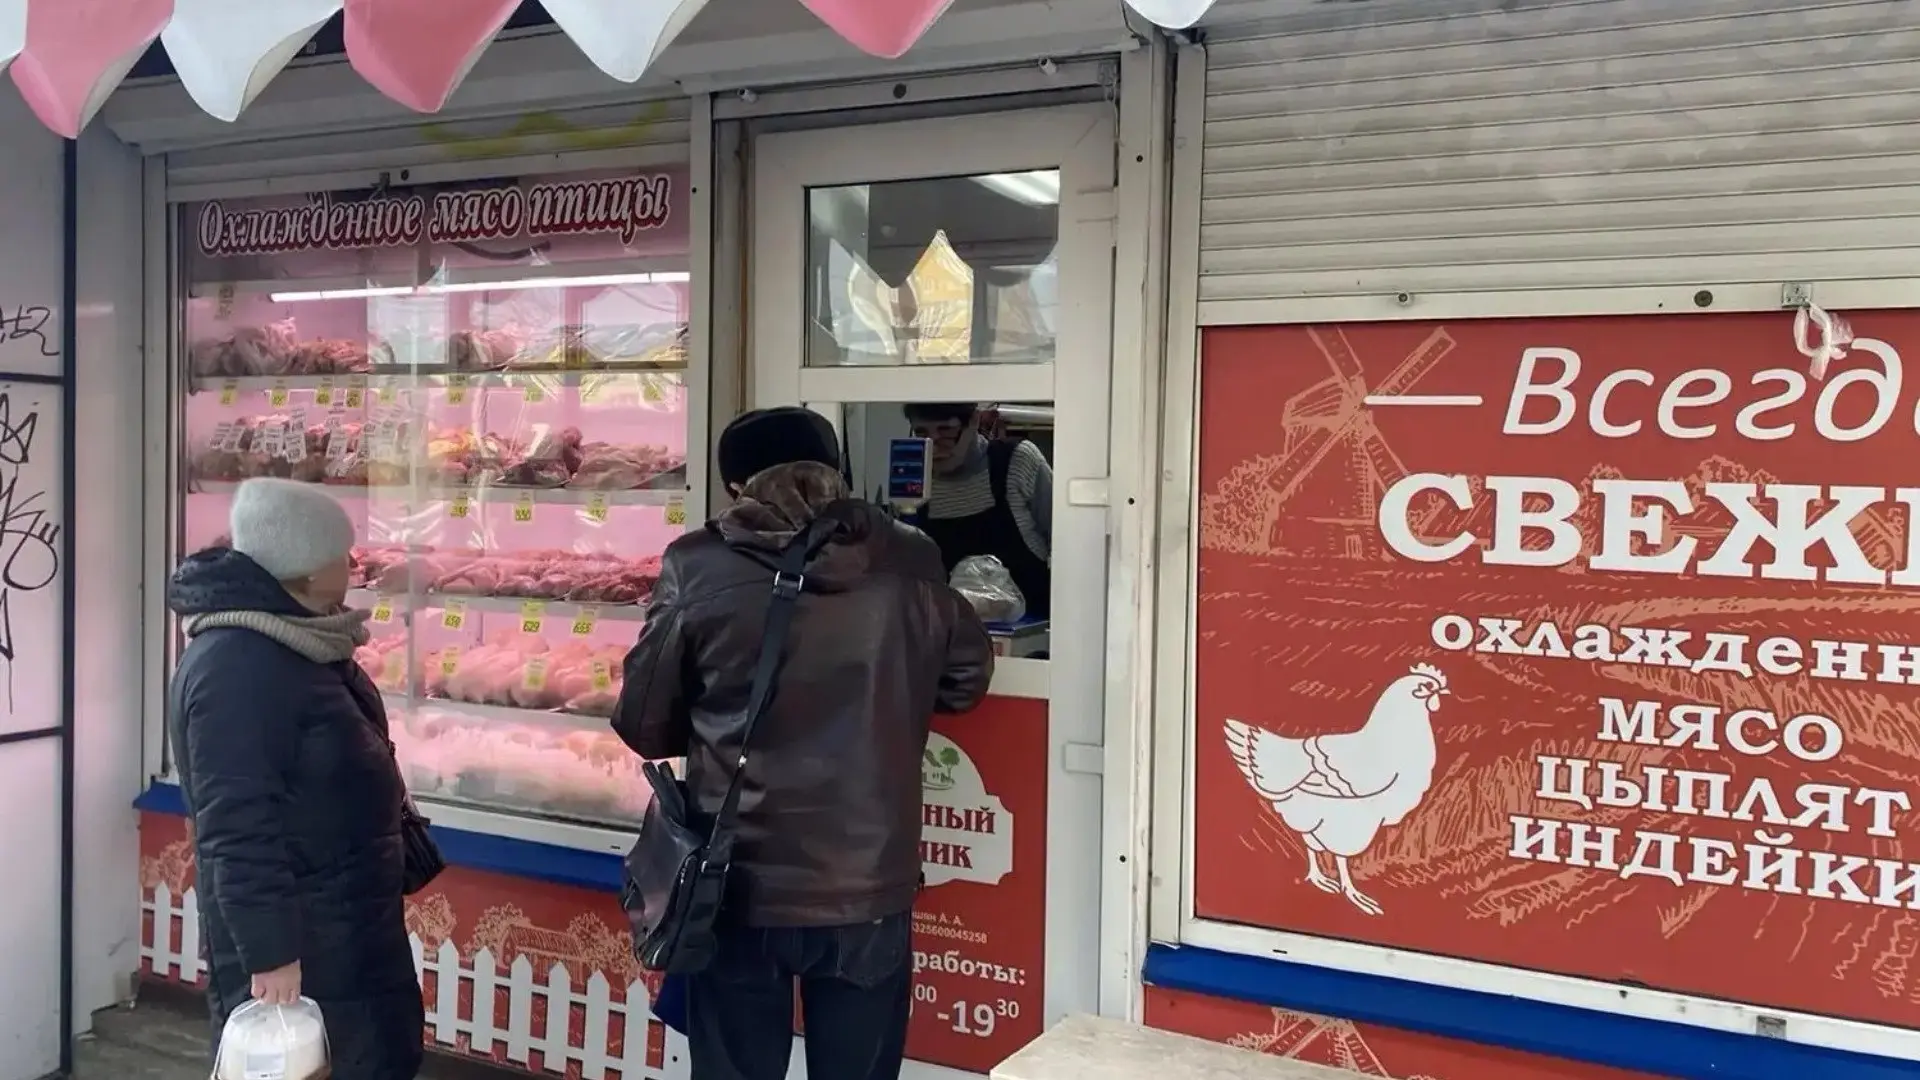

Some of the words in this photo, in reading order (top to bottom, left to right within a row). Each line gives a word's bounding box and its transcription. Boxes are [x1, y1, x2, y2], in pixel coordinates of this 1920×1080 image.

[200, 189, 422, 253] Охлажденное
[430, 189, 523, 240] мясо
[528, 175, 668, 243] птицы
[1503, 338, 1920, 441] Всегд
[1379, 473, 1920, 585] СВЕЖ
[1597, 697, 1844, 761] МЯСО
[1536, 754, 1911, 838] ЦЫПЛЯТ
[912, 950, 1026, 986] работы:
